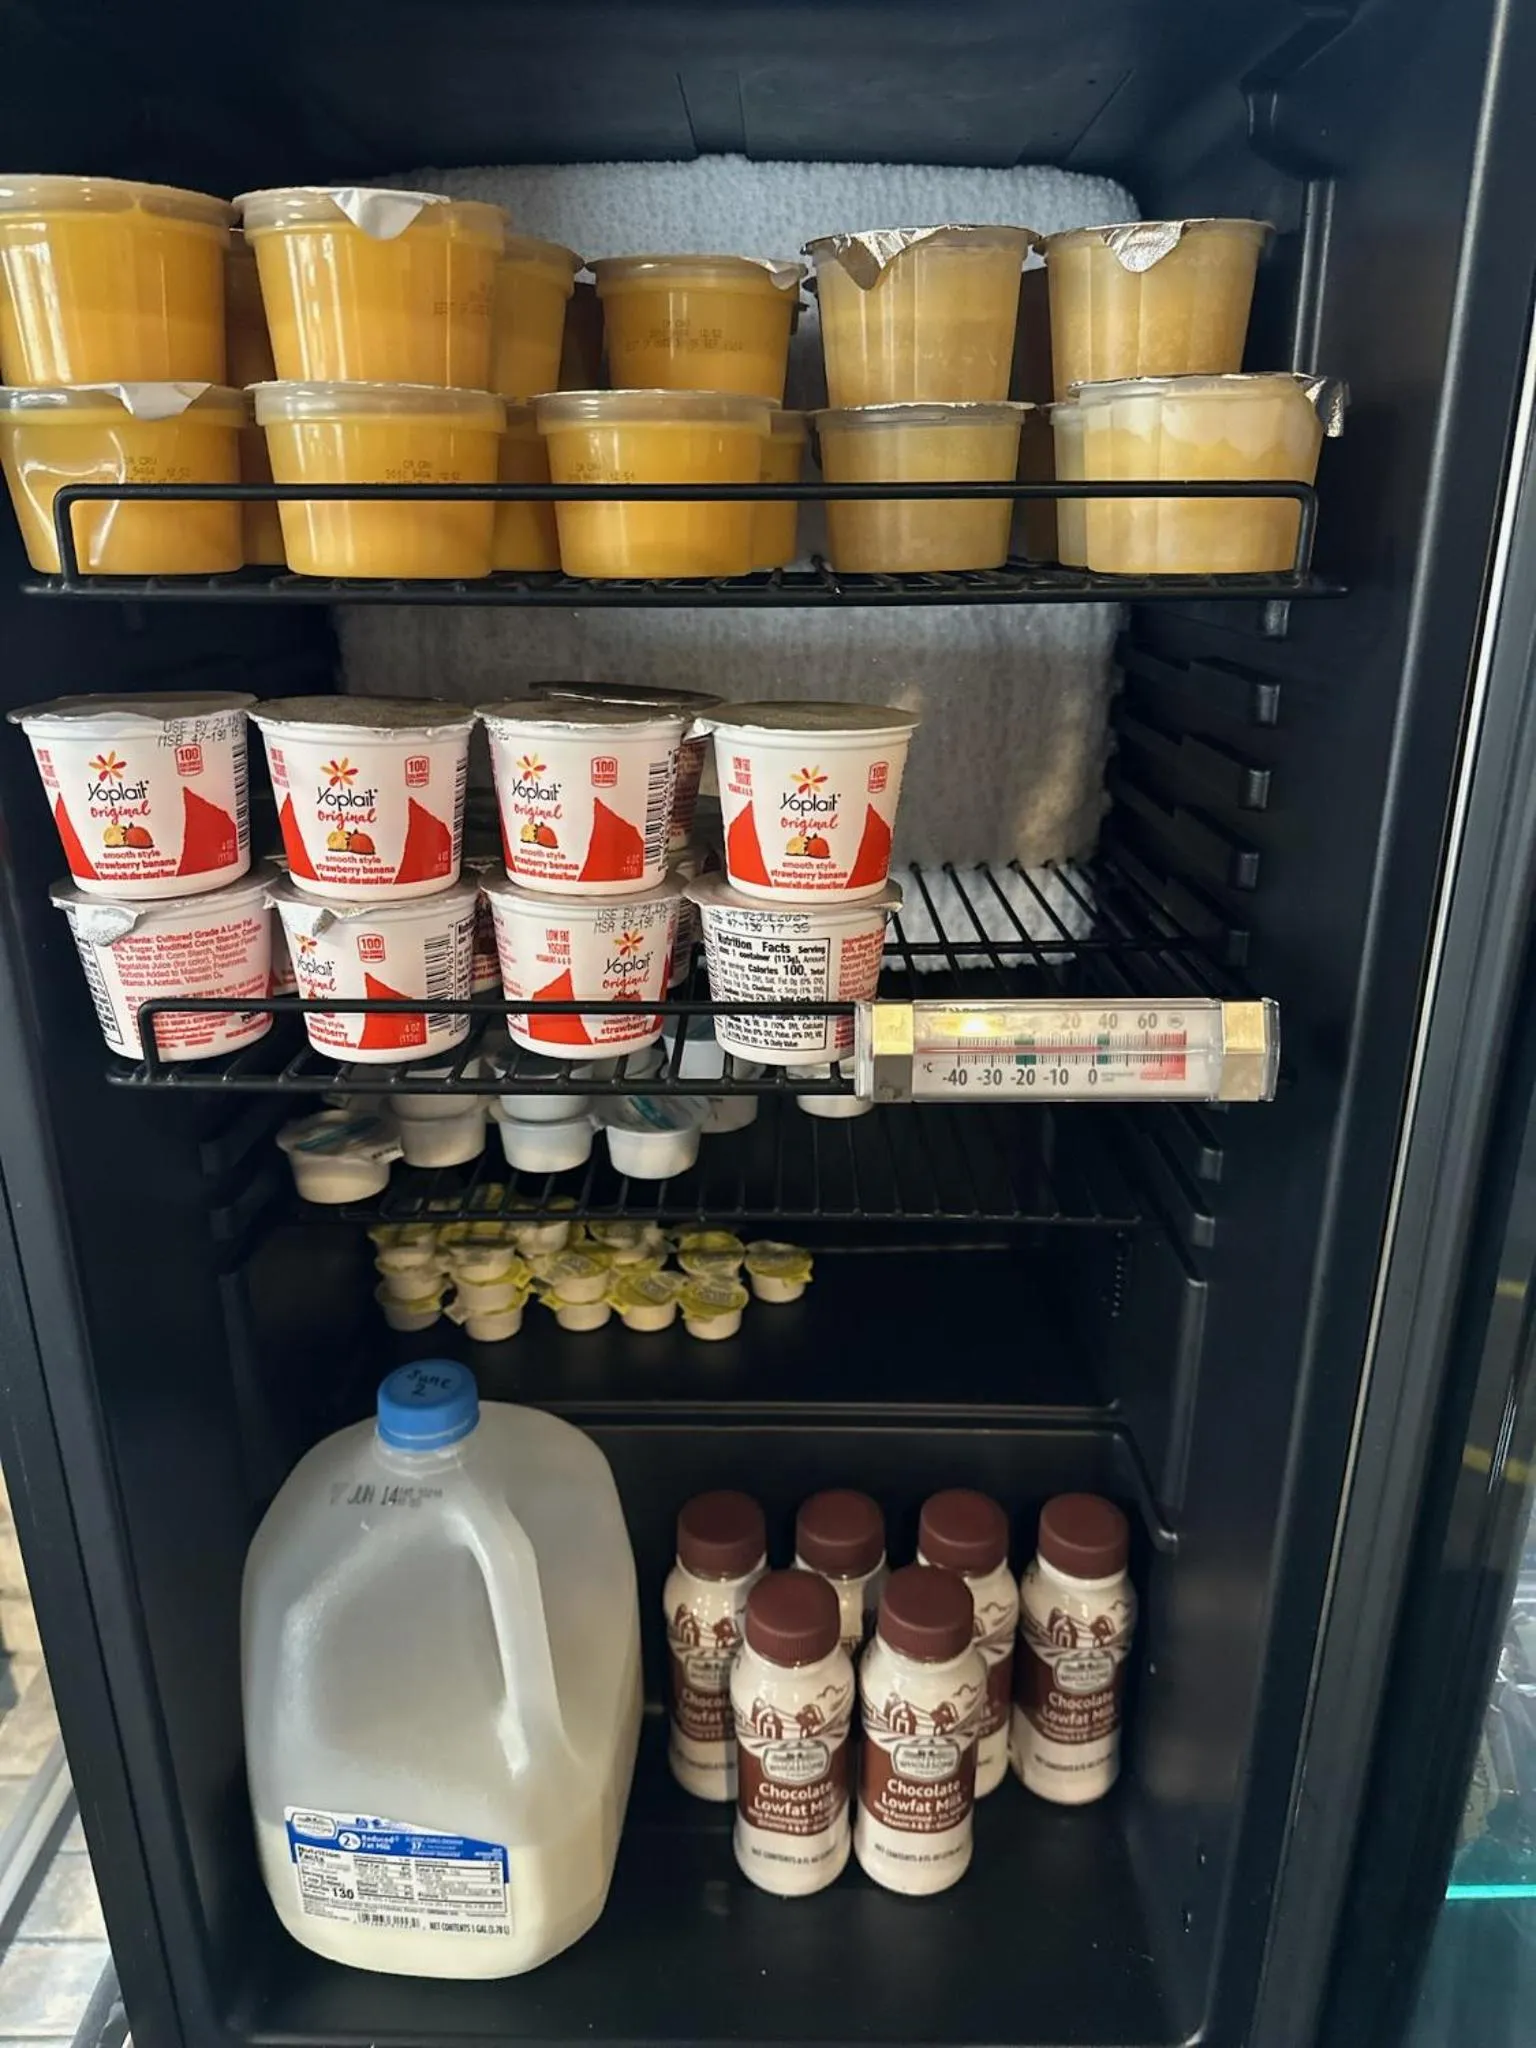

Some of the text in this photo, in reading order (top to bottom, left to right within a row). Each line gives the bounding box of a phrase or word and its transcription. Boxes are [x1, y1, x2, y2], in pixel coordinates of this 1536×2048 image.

[163, 719, 208, 734] USE BY
[178, 747, 199, 761] 100
[408, 760, 427, 773] 100
[594, 760, 614, 773] 100
[88, 780, 148, 806] Yoplait
[511, 779, 559, 803] Yoplait
[316, 787, 376, 811] Yoplait
[780, 793, 838, 817] Yoplait
[90, 800, 150, 825] Original
[317, 808, 377, 830] Original
[514, 803, 563, 824] Original
[781, 814, 839, 836] Original
[103, 849, 161, 859] smooth style
[325, 855, 381, 865] smooth style
[546, 850, 566, 860] style
[95, 859, 177, 871] strawberry banana
[316, 863, 395, 875] strawberry banana
[549, 861, 579, 871] banana
[782, 861, 837, 871] smooth style
[771, 870, 848, 881] strawberry banana
[598, 908, 618, 920] USE
[156, 932, 192, 943] Cultured
[194, 928, 219, 939] Grade
[228, 923, 243, 932] Low
[157, 941, 193, 951] Modified
[361, 937, 382, 949] 100
[717, 933, 826, 954] Nutrition Facts Serving
[739, 952, 770, 960] container
[604, 952, 650, 977] Yoplait
[748, 964, 779, 975] Calories
[146, 969, 171, 978] Added
[185, 972, 213, 984] Vitamin
[602, 970, 650, 992] Original
[601, 1021, 648, 1035] strawberry
[802, 1022, 824, 1030] Calcium
[1060, 1012, 1158, 1030] 20 40 60
[942, 1069, 968, 1086] -40
[976, 1069, 1003, 1086] -30
[1010, 1069, 1036, 1086] -20
[1043, 1069, 1069, 1086] -10
[1088, 1068, 1098, 1086] 0
[411, 1383, 427, 1397] 2
[1048, 1691, 1114, 1707] Chocolate
[758, 1782, 834, 1800] Chocolate
[887, 1778, 961, 1798] Chocolate
[754, 1796, 808, 1816] Lowfat
[881, 1791, 932, 1814] Lowfat
[332, 1888, 355, 1900] 130
